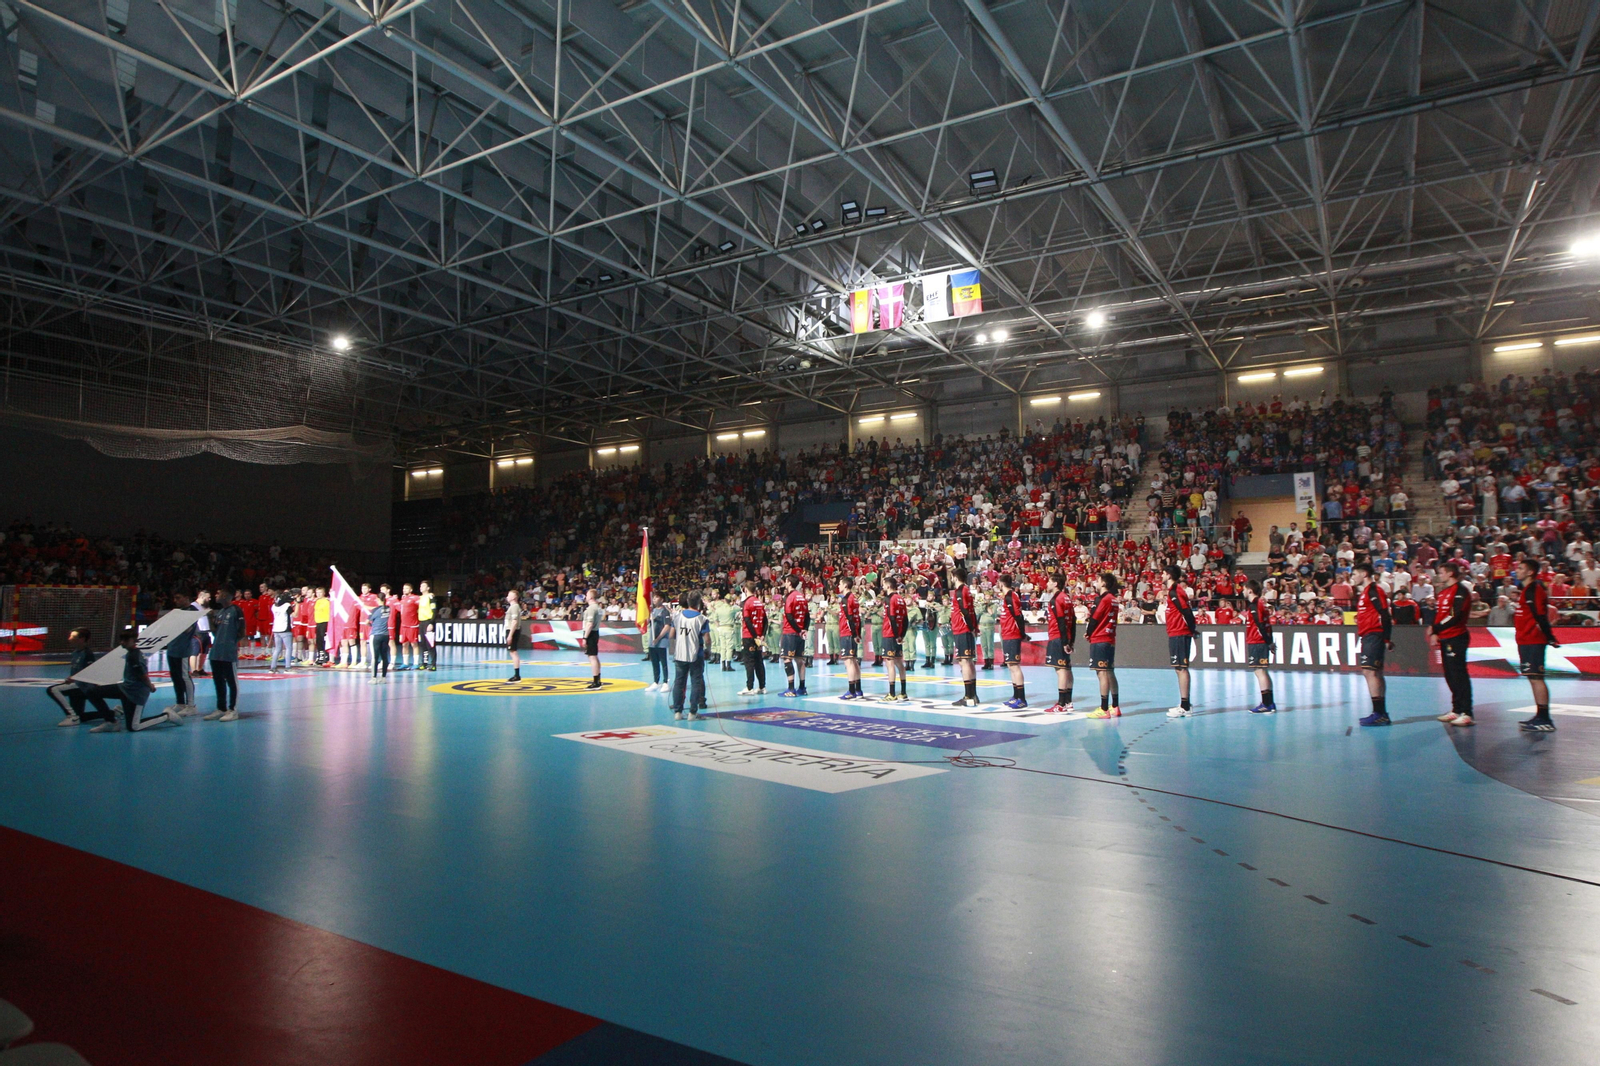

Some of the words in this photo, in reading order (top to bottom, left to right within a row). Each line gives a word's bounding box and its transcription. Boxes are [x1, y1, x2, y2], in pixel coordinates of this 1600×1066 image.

[435, 622, 507, 644] DENMARK
[680, 626, 691, 636] TV
[649, 743, 752, 765] CIUDAD
